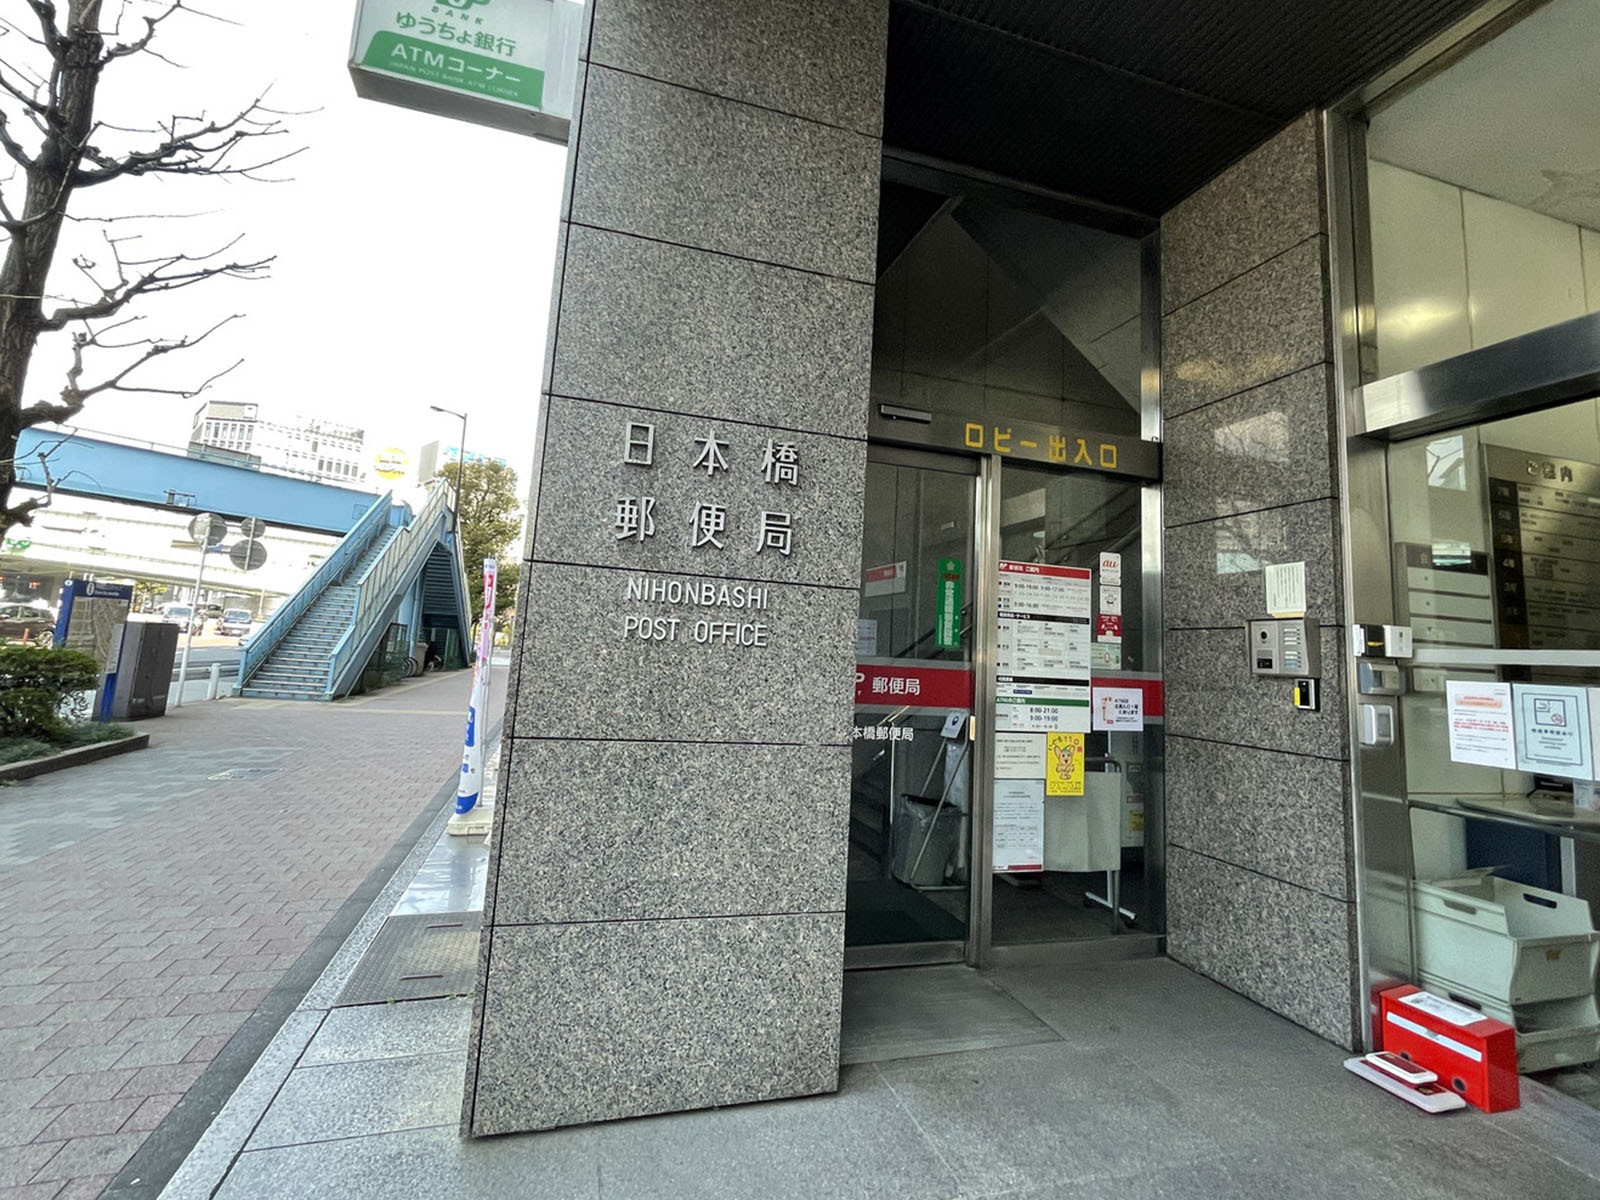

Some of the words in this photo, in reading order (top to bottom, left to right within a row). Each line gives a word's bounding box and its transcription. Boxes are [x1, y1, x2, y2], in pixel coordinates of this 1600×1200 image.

[431, 5, 485, 25] BANK
[396, 11, 517, 57] ゆうちょ銀行
[389, 61, 417, 73] JAPAN
[418, 66, 440, 78] POST
[391, 43, 521, 83] ATMコーナー
[624, 421, 799, 486] 日本橋
[965, 422, 1118, 469] ロビー出入口
[614, 496, 793, 556] 郵便局
[1102, 559, 1119, 569] au
[627, 577, 769, 609] NIHONBASHI
[624, 616, 681, 641] POST
[694, 619, 768, 647] OFFICE
[872, 676, 921, 696] 郵便局
[853, 725, 914, 742] 本橋郵便局
